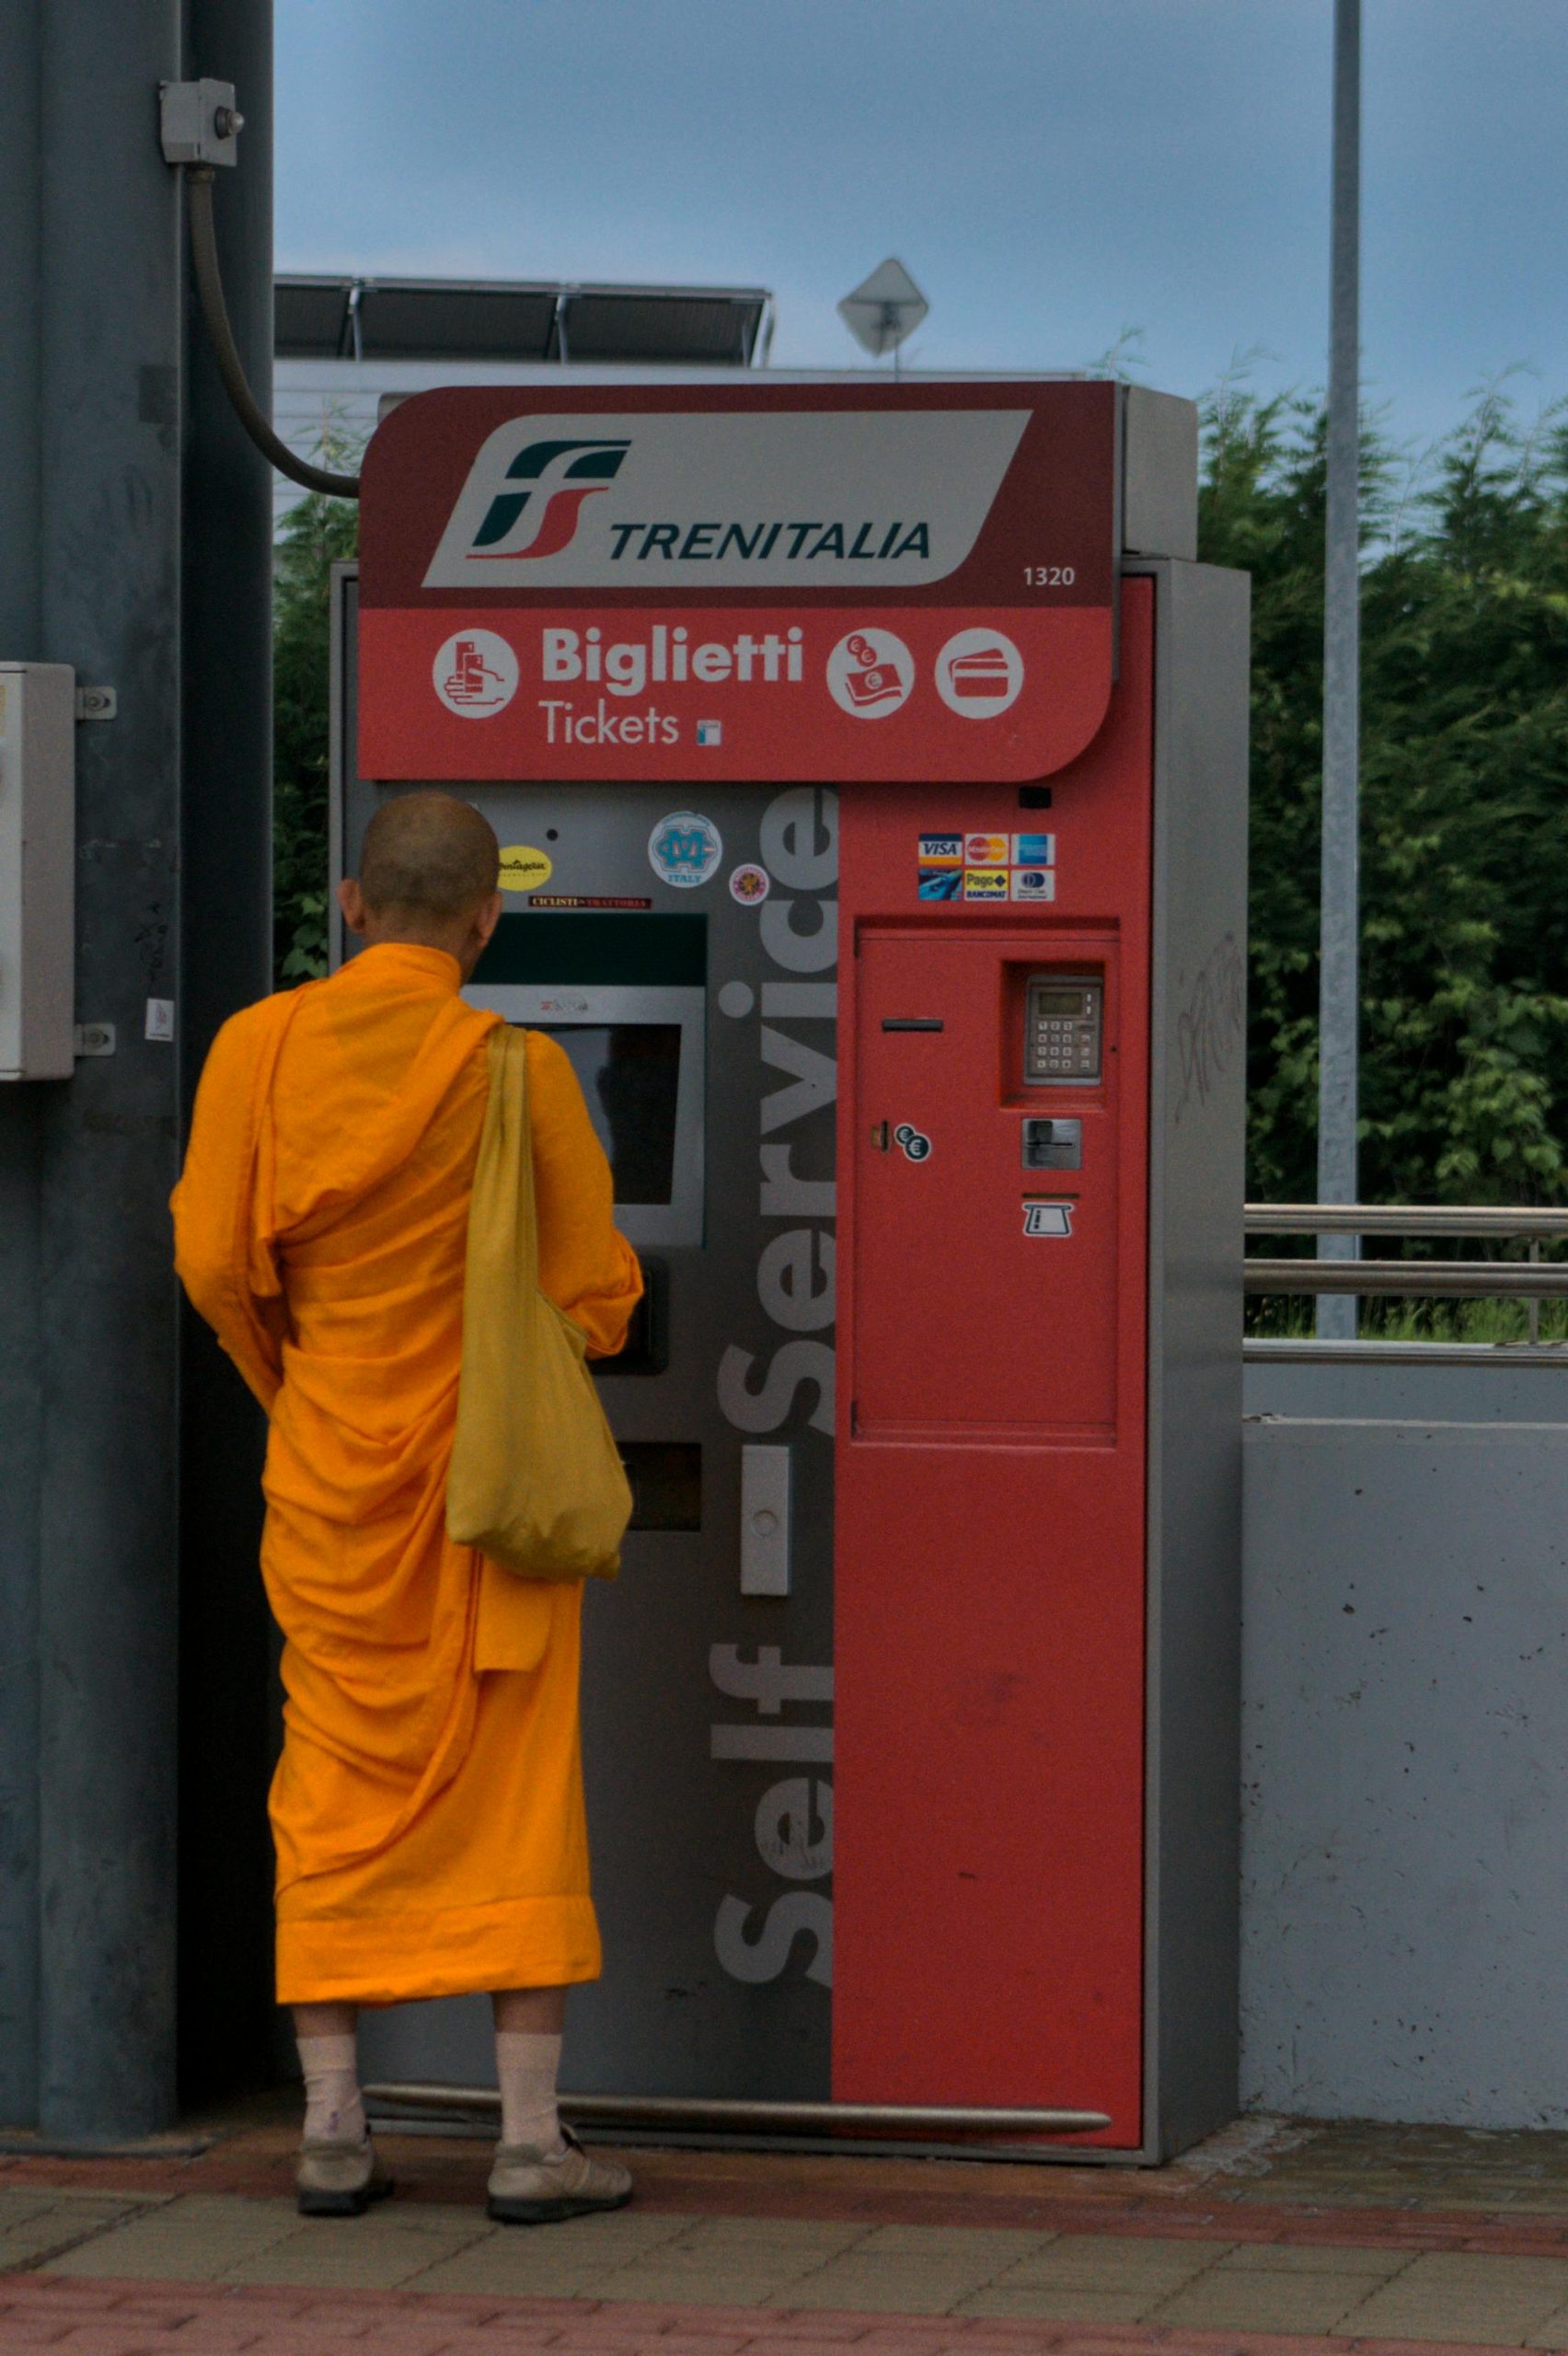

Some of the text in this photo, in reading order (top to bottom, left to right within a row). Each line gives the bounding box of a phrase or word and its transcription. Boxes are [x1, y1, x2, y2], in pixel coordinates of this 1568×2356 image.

[609, 521, 931, 560] TRENITALIA
[1023, 566, 1076, 587] 1320
[541, 626, 804, 697] Biglietti
[537, 699, 680, 746] Tickets
[924, 843, 957, 856] VISA
[668, 873, 702, 884] ITALY
[966, 872, 994, 889] Pago
[531, 896, 578, 907] CICLISTI
[966, 891, 1006, 899] BANCOMAT
